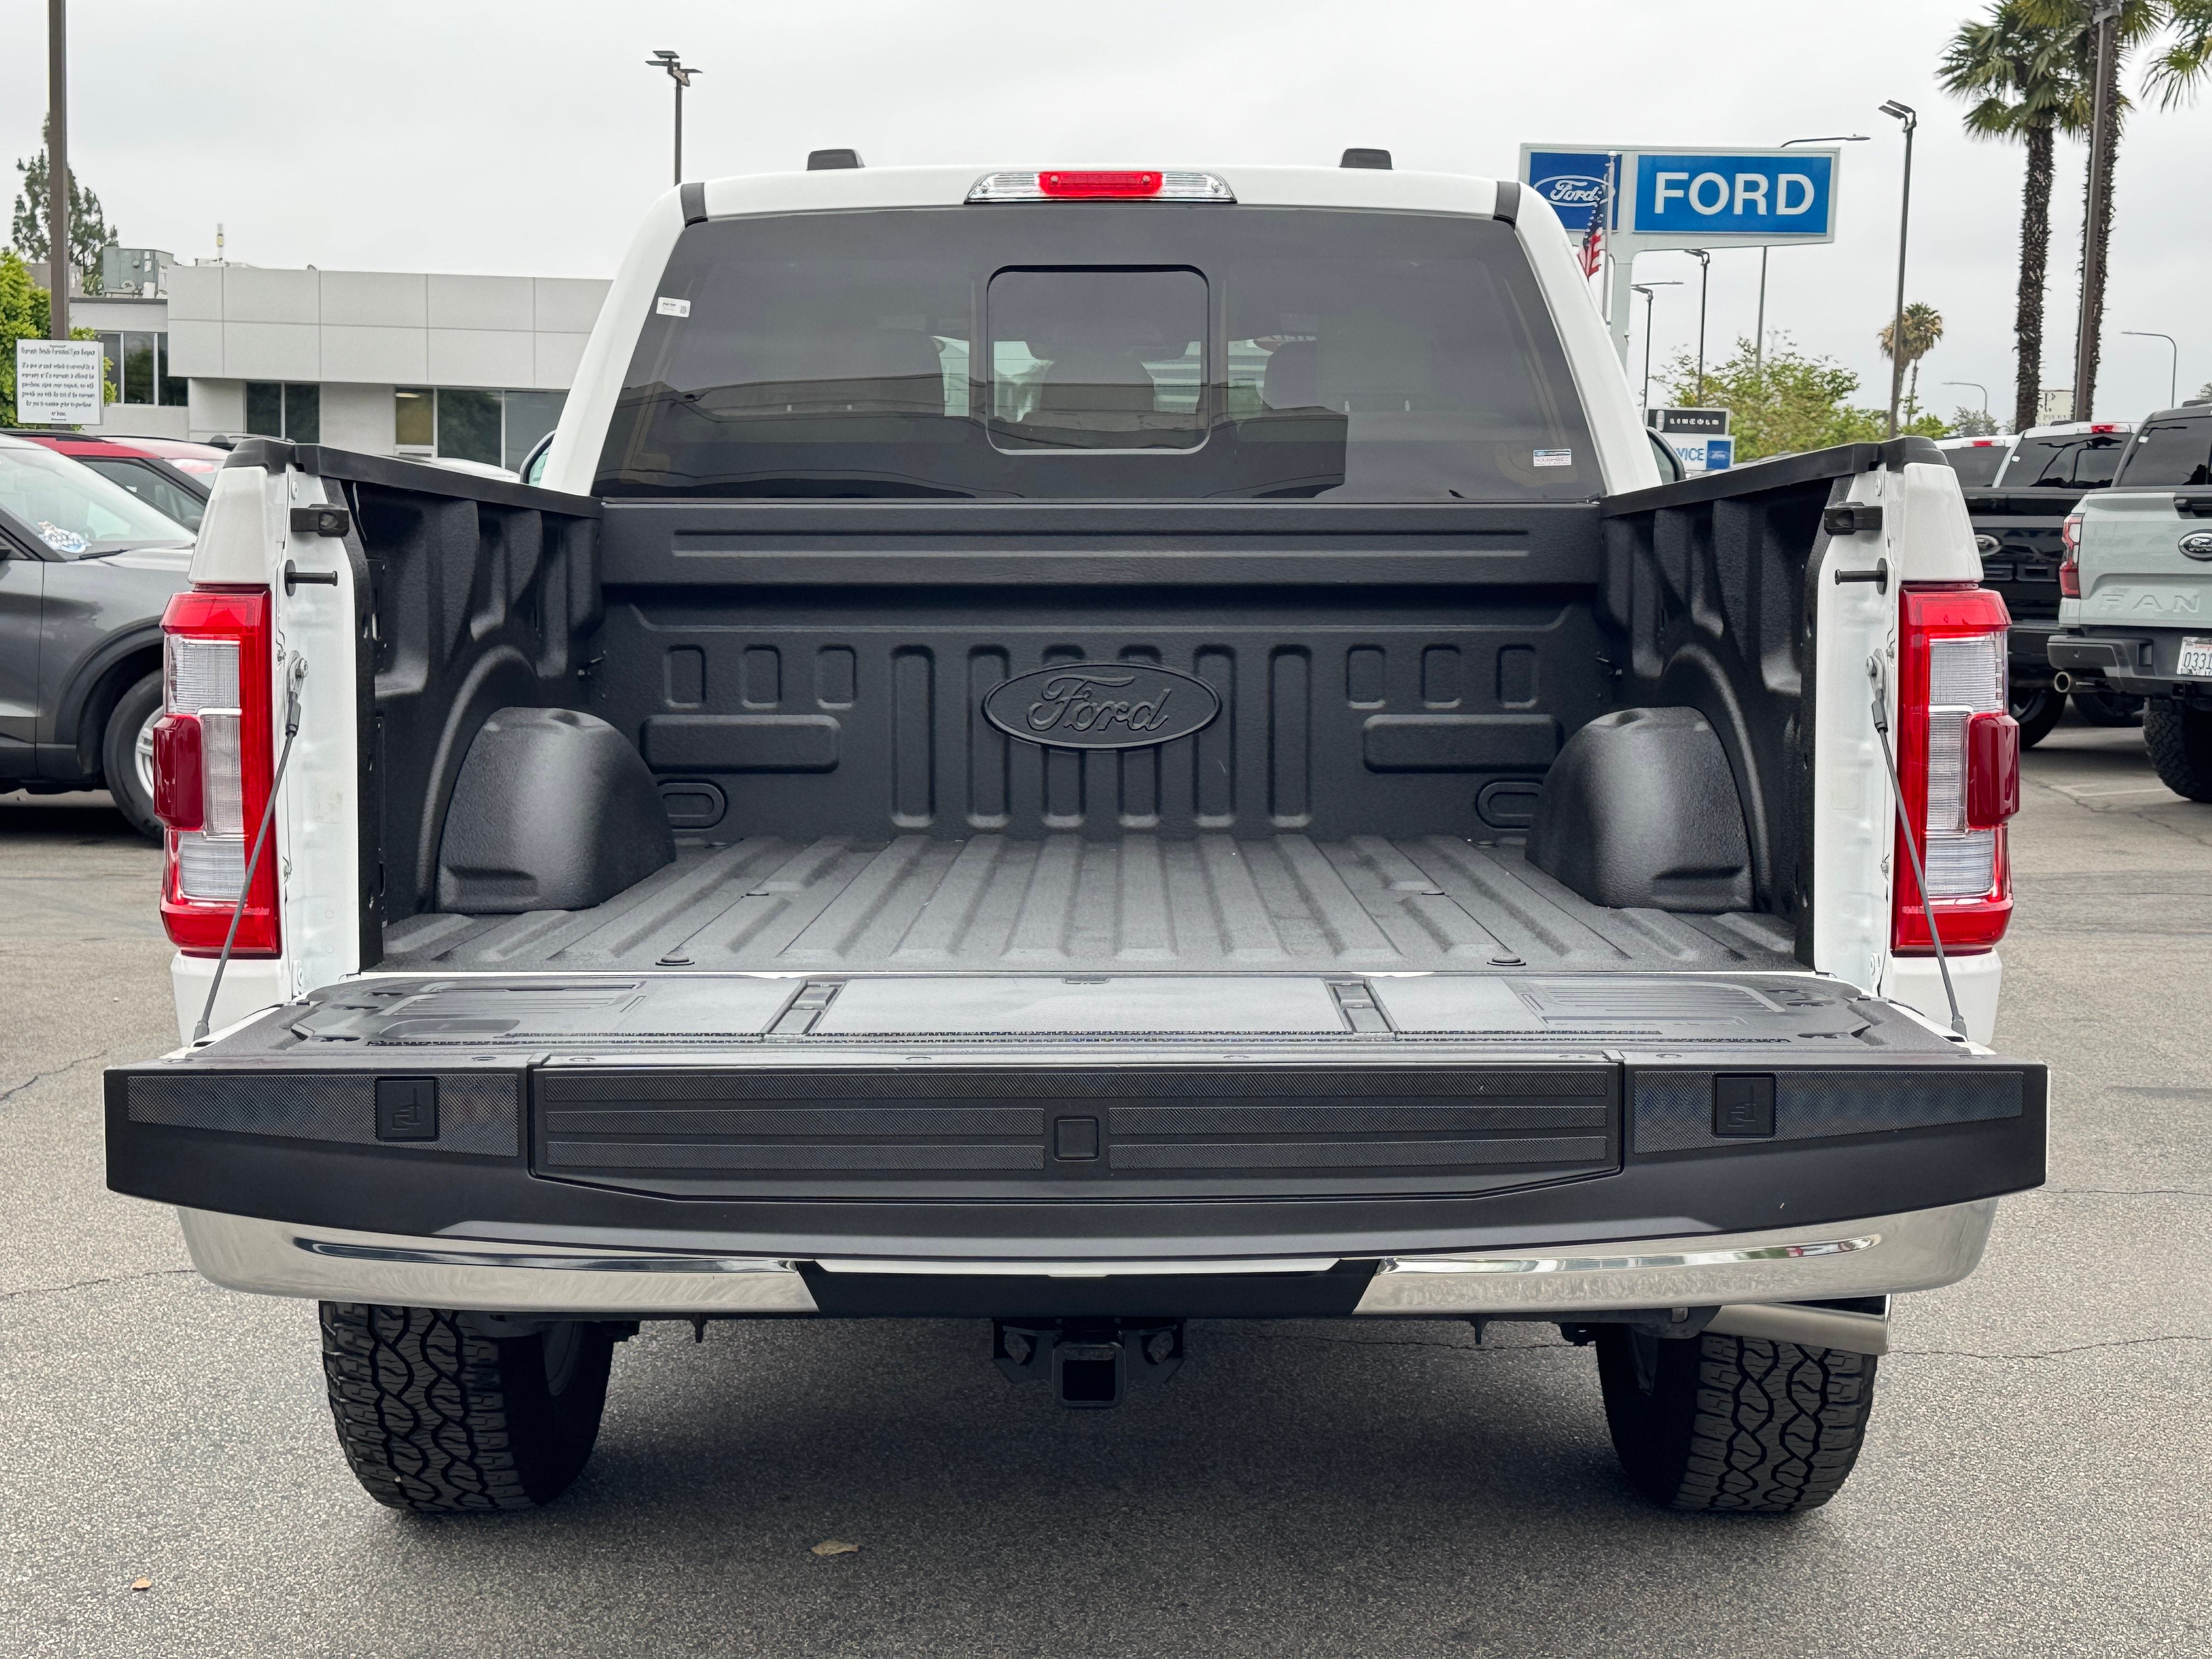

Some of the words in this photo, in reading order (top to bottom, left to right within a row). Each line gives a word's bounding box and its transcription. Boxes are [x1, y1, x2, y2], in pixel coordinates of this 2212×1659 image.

[1550, 180, 1600, 201] Ford
[1655, 172, 1814, 215] FORD
[1026, 673, 1172, 731] Ford
